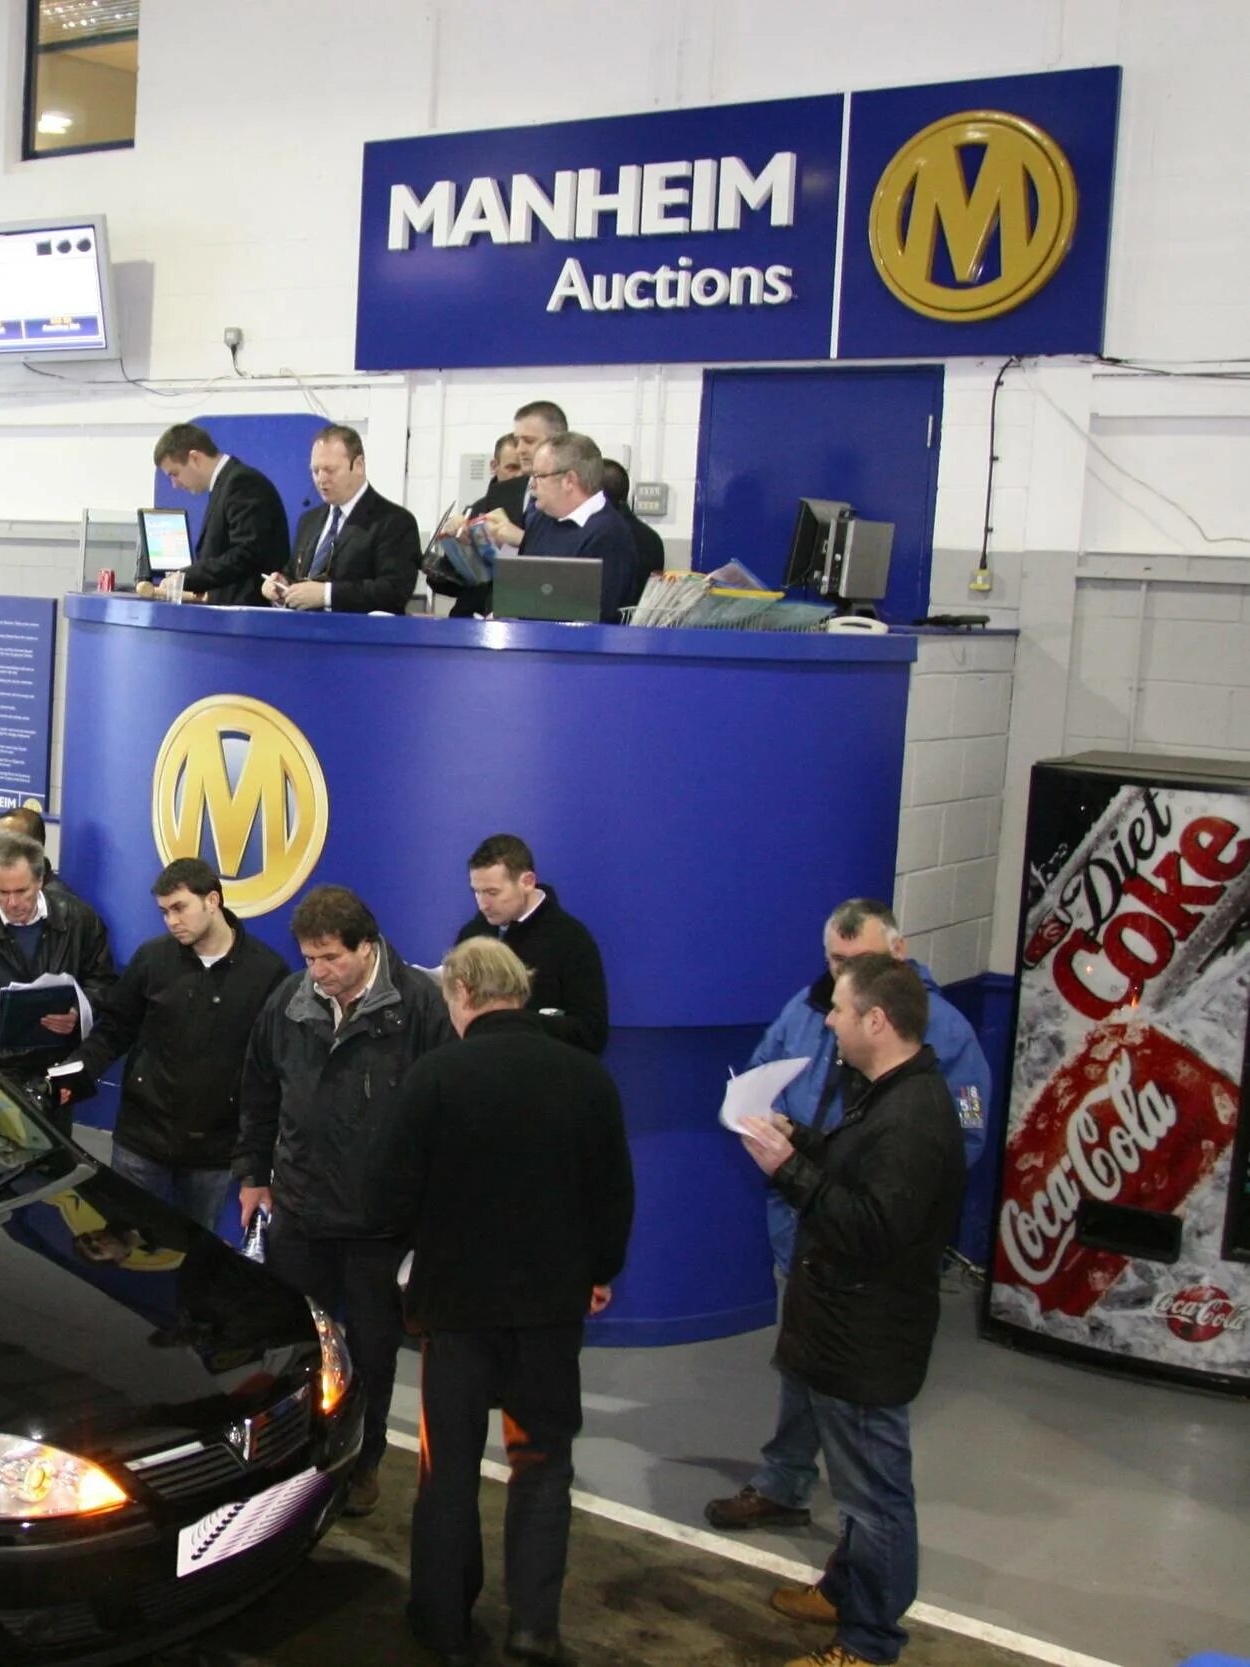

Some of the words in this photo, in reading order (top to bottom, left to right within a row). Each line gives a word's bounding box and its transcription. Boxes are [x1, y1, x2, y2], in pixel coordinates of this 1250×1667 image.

[388, 151, 797, 250] MANHEIM
[546, 256, 794, 313] Auctions
[1053, 816, 1250, 1021] Coke
[1061, 788, 1172, 940] Diet
